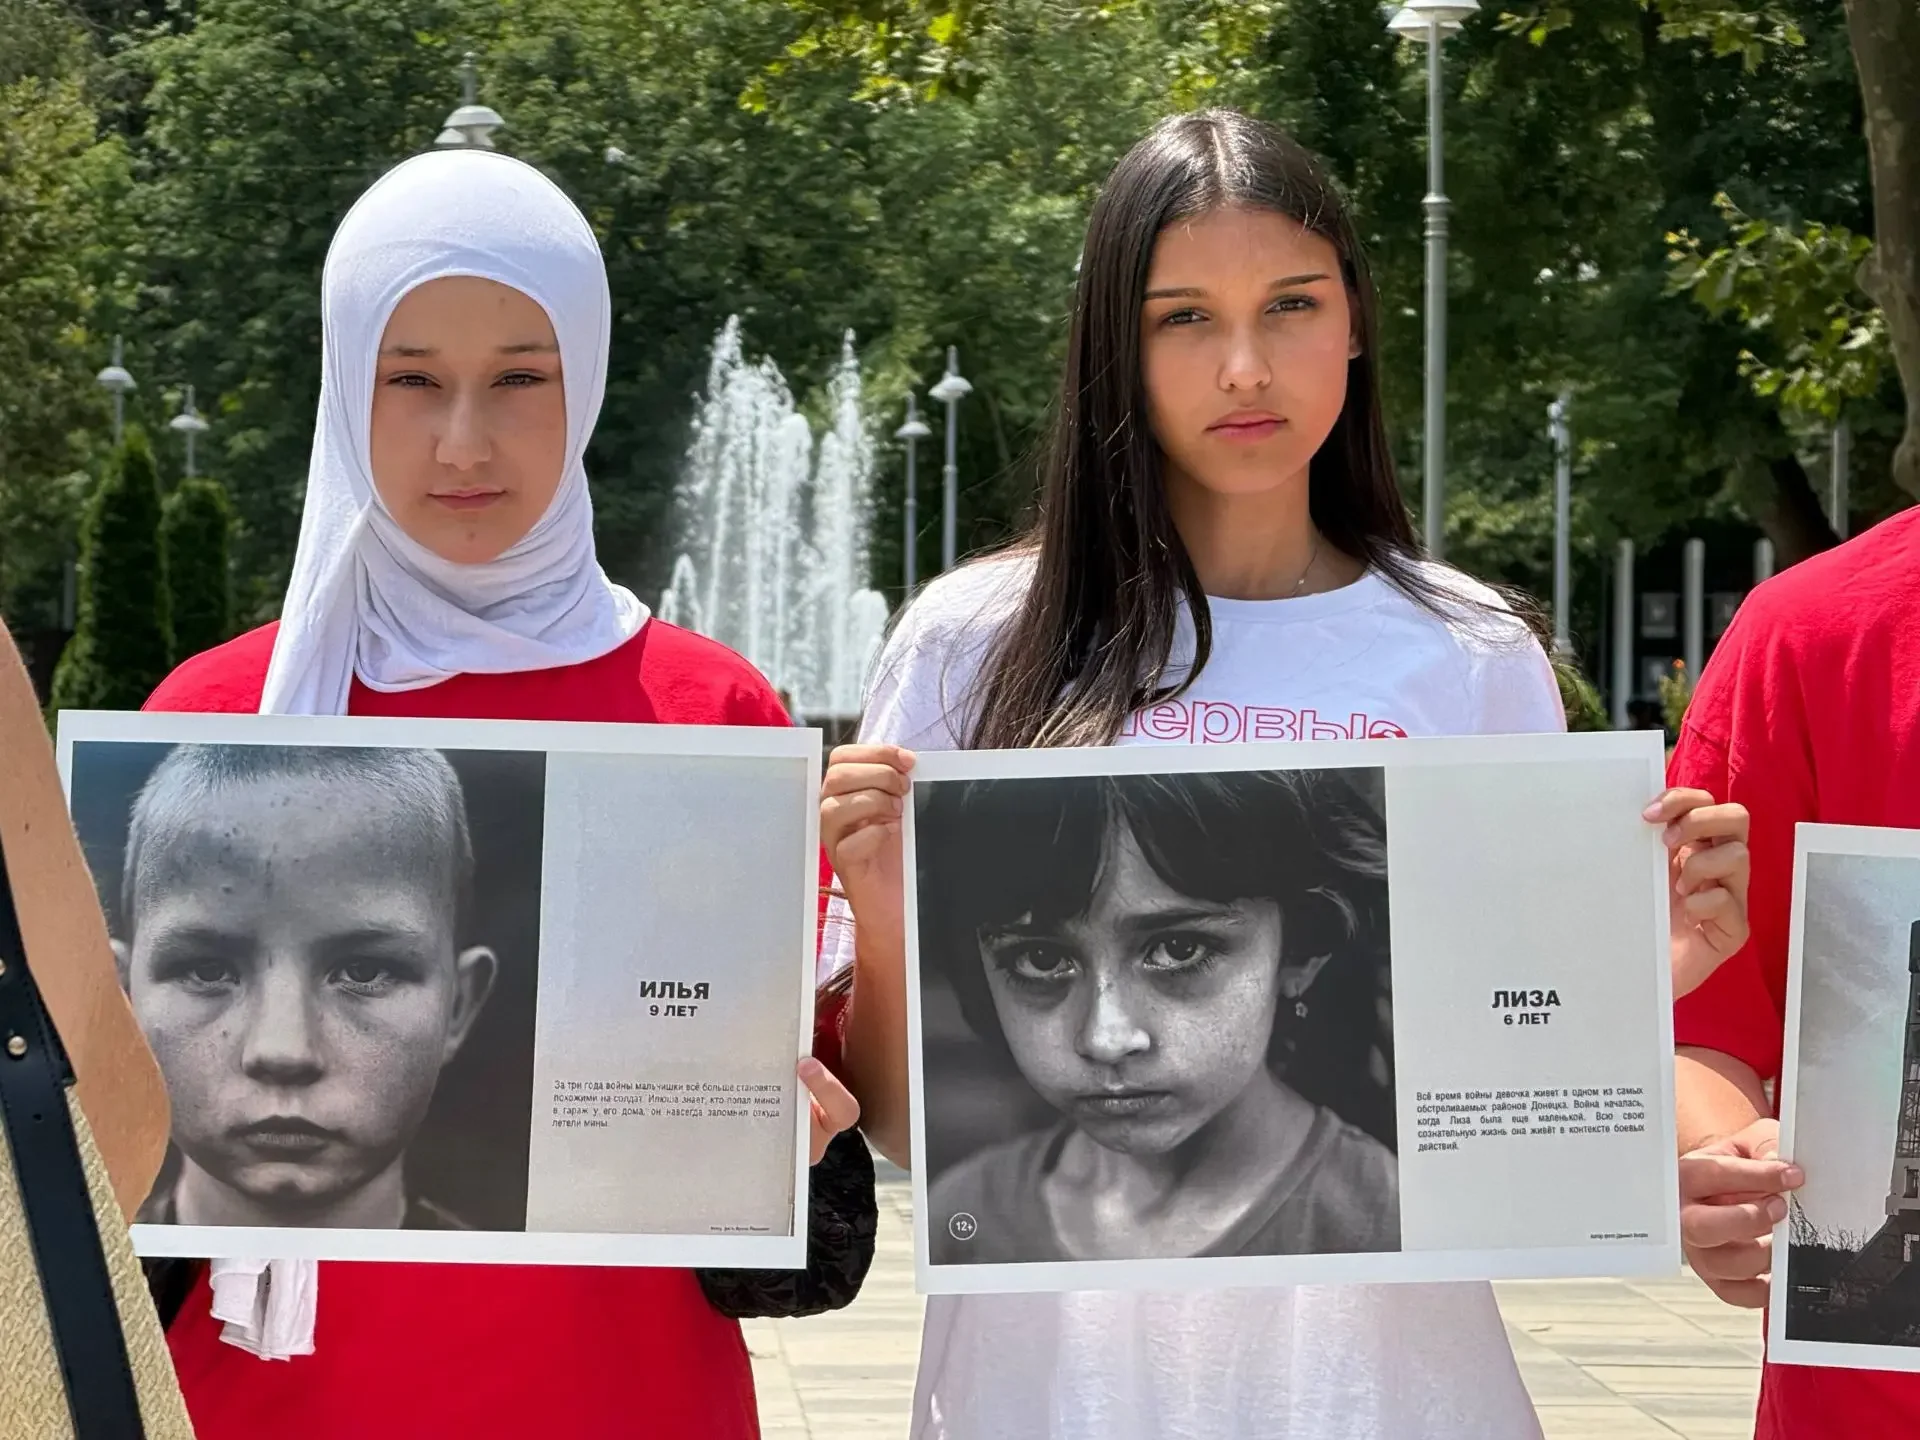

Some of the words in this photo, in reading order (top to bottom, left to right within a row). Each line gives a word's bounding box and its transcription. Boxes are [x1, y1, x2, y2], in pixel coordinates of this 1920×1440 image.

[1121, 699, 1408, 744] ервы
[640, 981, 709, 999] ИЛЬЯ
[1492, 990, 1561, 1008] ЛИЗА
[650, 1005, 659, 1016] 9
[664, 1005, 698, 1017] ЛЕТ
[1504, 1014, 1513, 1025] 6
[1518, 1013, 1551, 1024] ЛЕТ
[554, 1080, 565, 1090] За
[567, 1082, 582, 1092] три
[584, 1082, 603, 1091] года
[605, 1081, 633, 1090] войны
[635, 1082, 683, 1091] мальчишки
[702, 1083, 734, 1092] больше
[736, 1083, 781, 1092] становятся
[554, 1094, 597, 1103] похожими
[710, 1096, 724, 1104] кто
[754, 1096, 780, 1104] миной
[1435, 1092, 1461, 1102] время
[1465, 1091, 1492, 1099] войны
[1496, 1090, 1530, 1100] девочка
[1572, 1089, 1599, 1097] одном
[1603, 1088, 1613, 1096] из
[1616, 1087, 1643, 1095] самых
[563, 1107, 588, 1116] гараж
[593, 1108, 598, 1116] у
[603, 1107, 617, 1115] его
[651, 1108, 660, 1116] он
[666, 1108, 703, 1117] навсегда
[708, 1109, 748, 1117] запомнил
[752, 1110, 780, 1118] откуда
[1416, 1104, 1487, 1114] обстреливаемых
[1491, 1102, 1527, 1112] районов
[1573, 1099, 1600, 1108] Война
[552, 1119, 581, 1127] летели
[1417, 1117, 1440, 1126] когда
[1449, 1115, 1471, 1125] Лиза
[1480, 1115, 1502, 1124] была
[1538, 1113, 1586, 1122] маленькой.
[1595, 1111, 1614, 1121] Всю
[1622, 1112, 1645, 1120] свою
[1417, 1129, 1476, 1139] сознательную
[1480, 1128, 1507, 1136] жизнь
[1560, 1126, 1565, 1134] в
[1569, 1125, 1610, 1133] контексте
[1614, 1123, 1645, 1132] боевых
[1418, 1142, 1460, 1152] действий.
[956, 1221, 973, 1231] 12+
